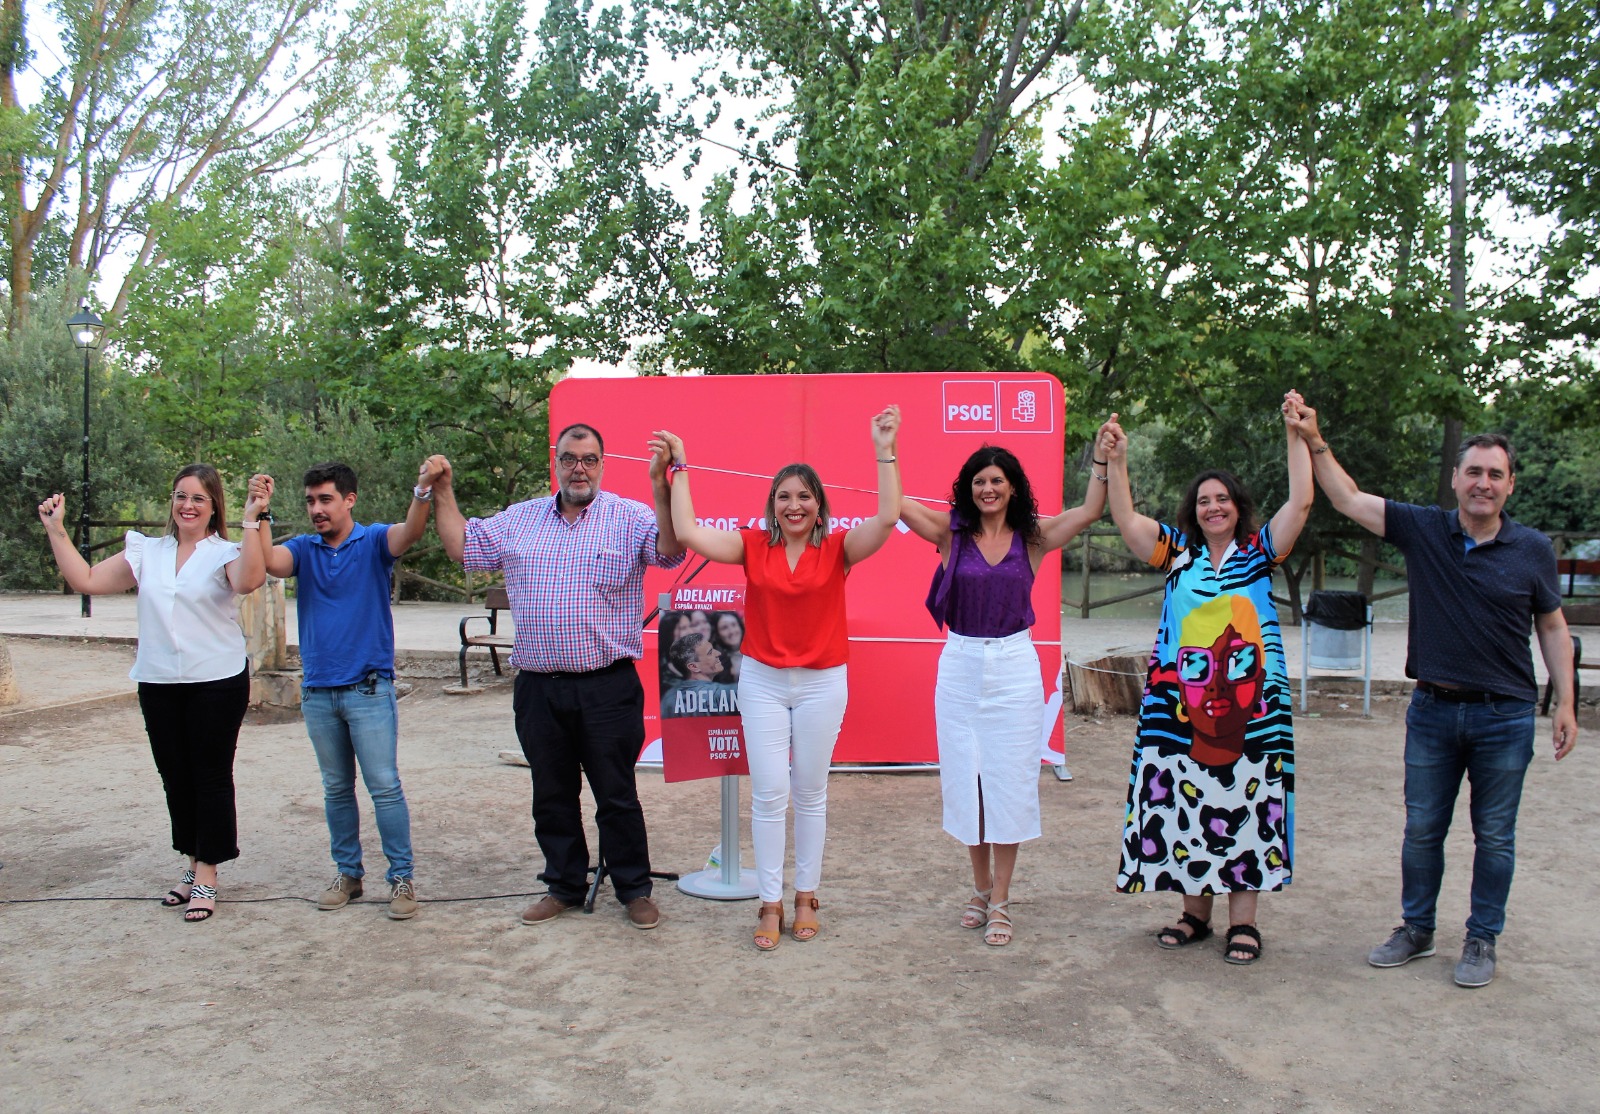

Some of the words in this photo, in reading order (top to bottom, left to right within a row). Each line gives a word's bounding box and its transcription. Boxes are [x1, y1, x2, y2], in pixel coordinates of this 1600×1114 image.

[948, 404, 993, 421] PSOE
[828, 517, 874, 534] PSO
[674, 588, 737, 603] ADELANTE
[674, 602, 693, 610] ESPAÑA
[674, 689, 741, 713] ADELAN
[708, 736, 740, 751] VOTA
[710, 752, 728, 760] PSOE
